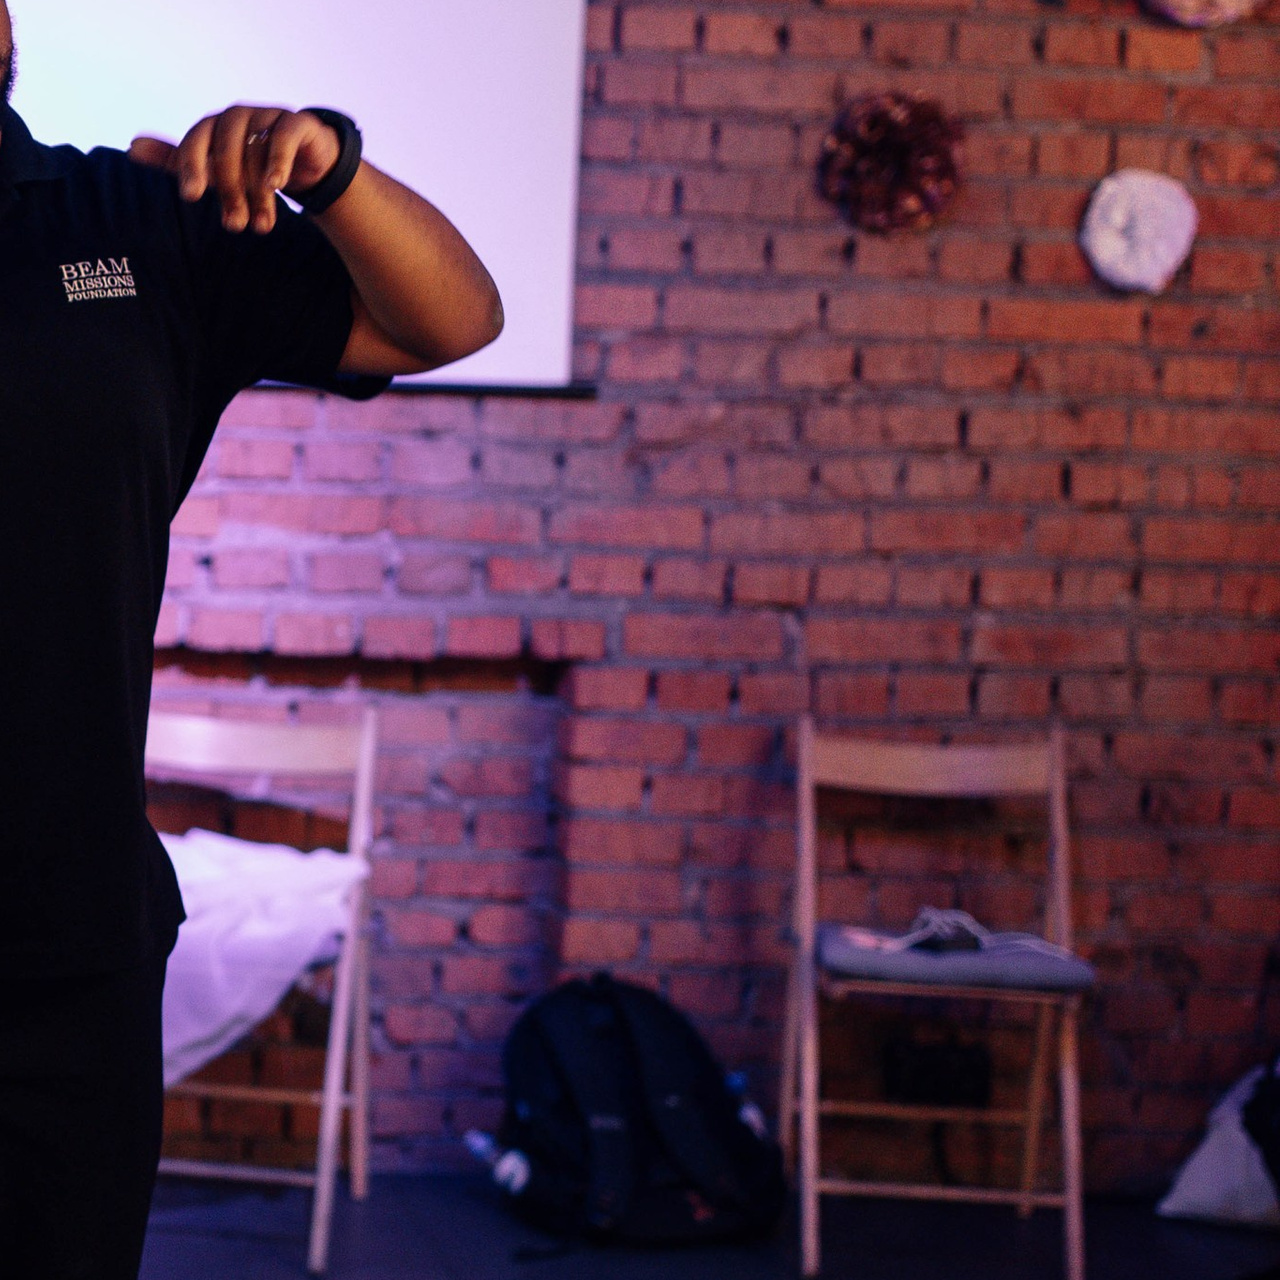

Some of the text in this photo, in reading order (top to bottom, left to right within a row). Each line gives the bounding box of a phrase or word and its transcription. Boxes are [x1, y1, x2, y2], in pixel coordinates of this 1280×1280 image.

[59, 257, 131, 280] BEAM
[63, 275, 135, 292] MISSIONS
[67, 288, 136, 302] FOUNDATION
